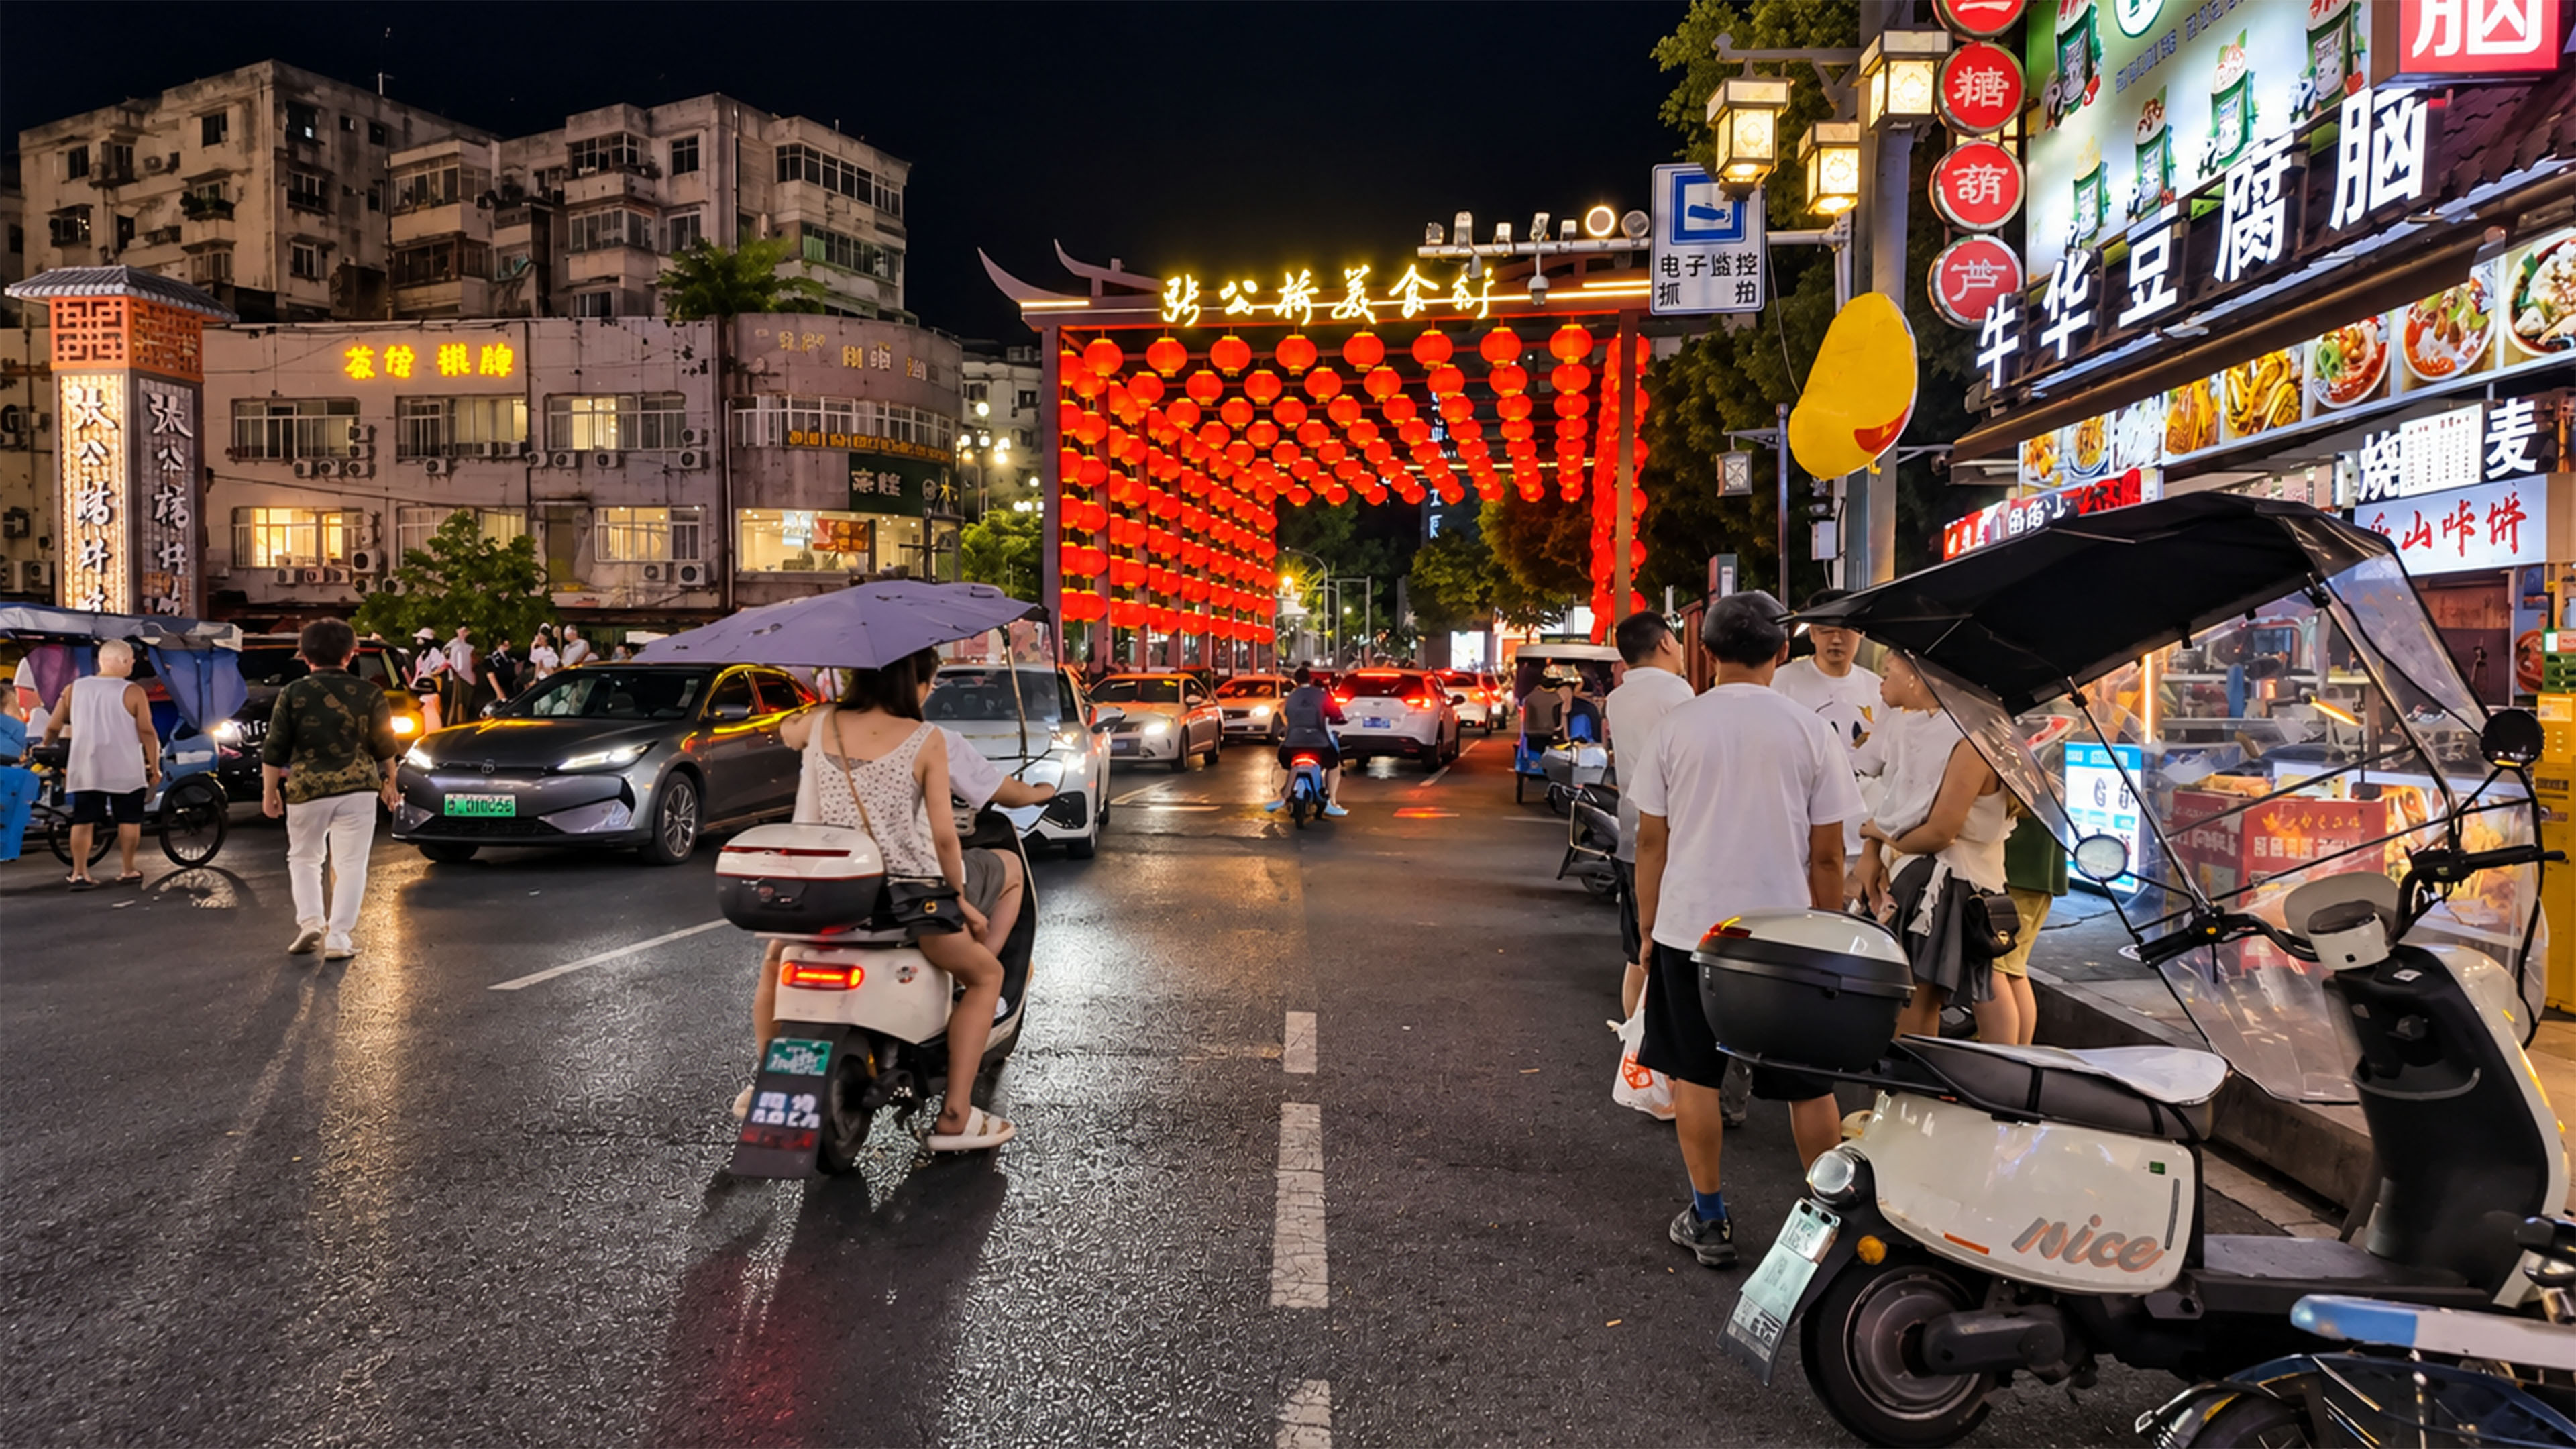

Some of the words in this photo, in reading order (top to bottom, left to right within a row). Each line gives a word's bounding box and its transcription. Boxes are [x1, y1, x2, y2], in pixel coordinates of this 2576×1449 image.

[1951, 0, 2012, 301] 糖葫芦
[1660, 252, 1758, 278] 电子监控
[1976, 87, 2428, 390] 牛华豆腐脑
[1162, 264, 1495, 326] 张公桥美食街
[1658, 280, 1756, 306] 抓拍
[2011, 1214, 2165, 1273] nice
